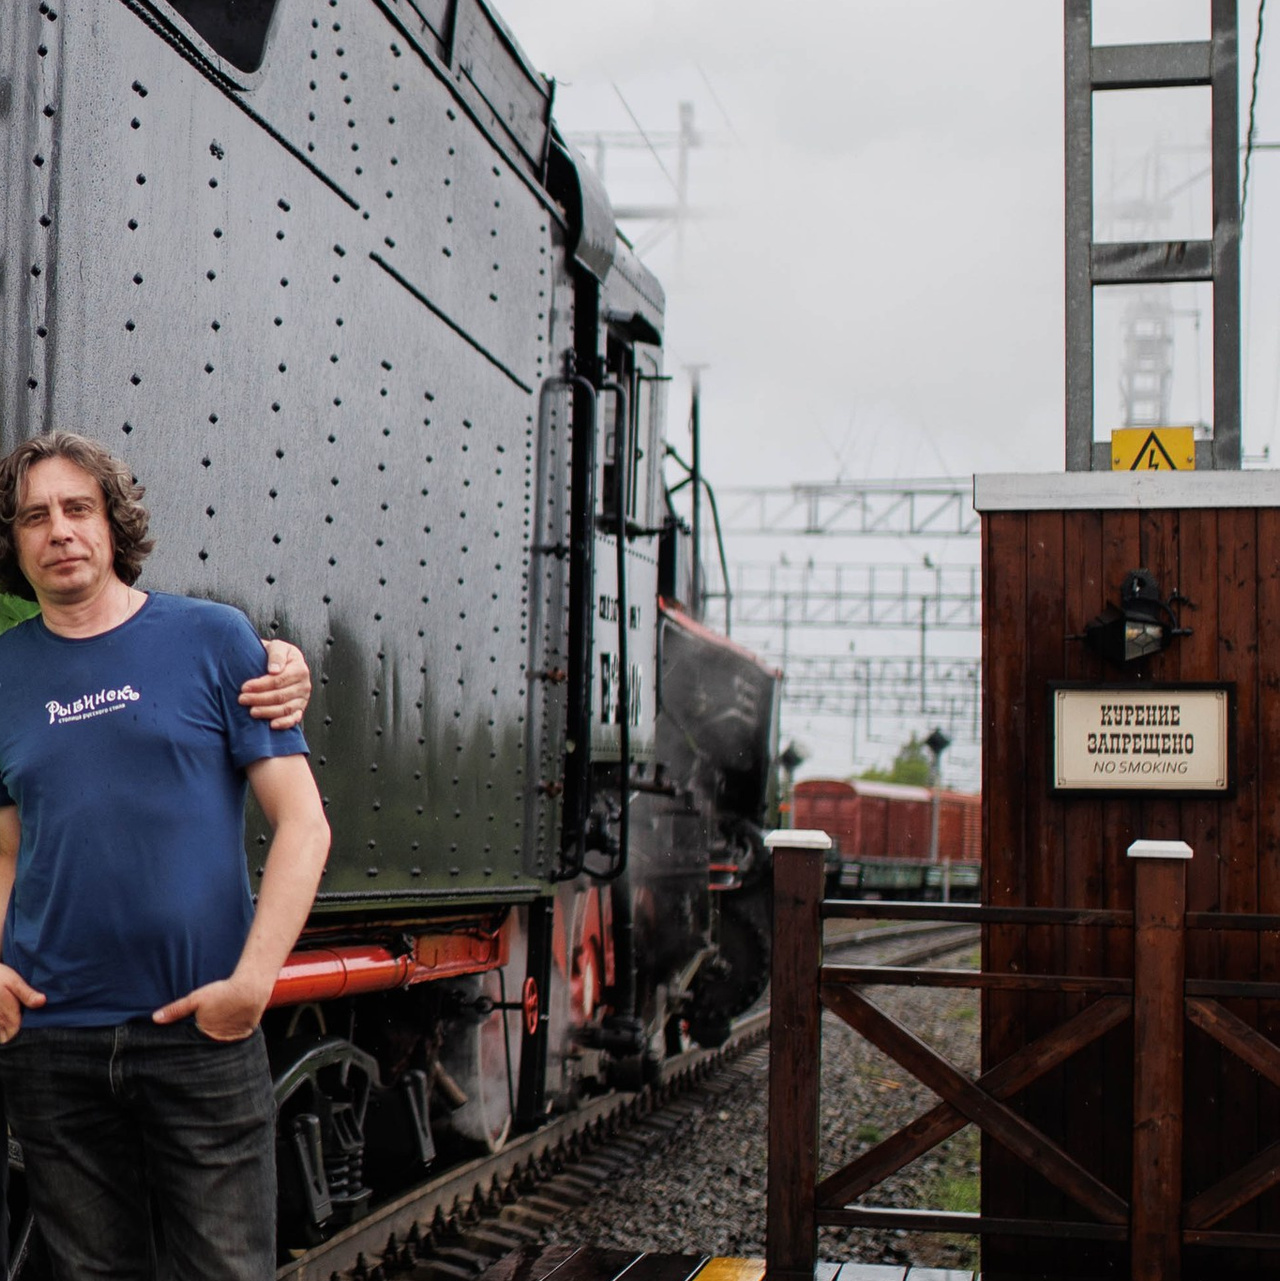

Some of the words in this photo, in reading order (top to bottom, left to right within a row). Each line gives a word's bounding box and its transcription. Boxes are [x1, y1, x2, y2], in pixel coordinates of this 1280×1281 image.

[1101, 705, 1180, 726] КУРЕНИЕ
[1087, 733, 1194, 756] ЗАПРЕЩЕНО
[1093, 761, 1116, 773] NO
[1119, 760, 1188, 774] SMOKING
